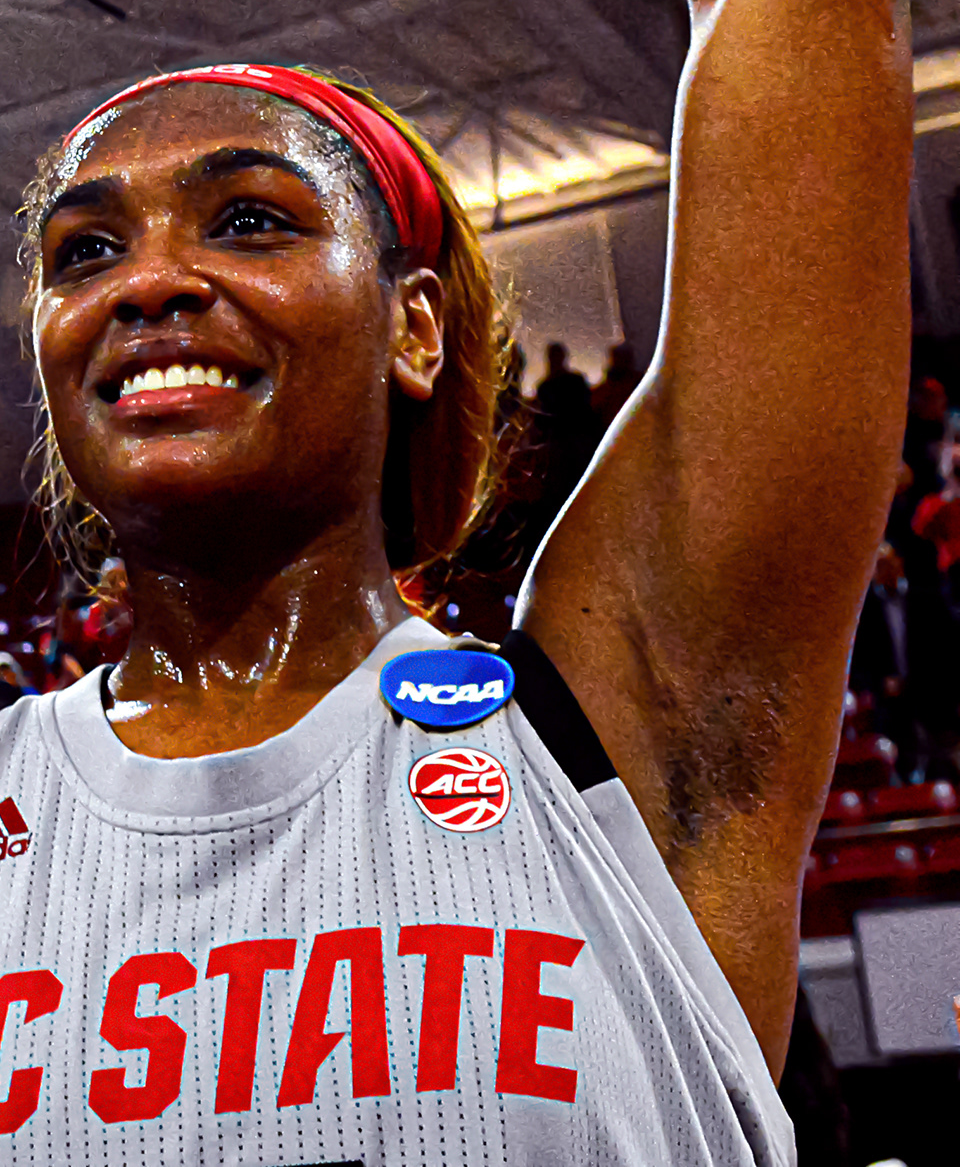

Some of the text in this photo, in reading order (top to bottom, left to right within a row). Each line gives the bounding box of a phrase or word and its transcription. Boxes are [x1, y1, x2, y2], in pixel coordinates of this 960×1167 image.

[396, 679, 504, 705] NCAA
[421, 768, 501, 795] ACC
[89, 924, 585, 1123] STATE
